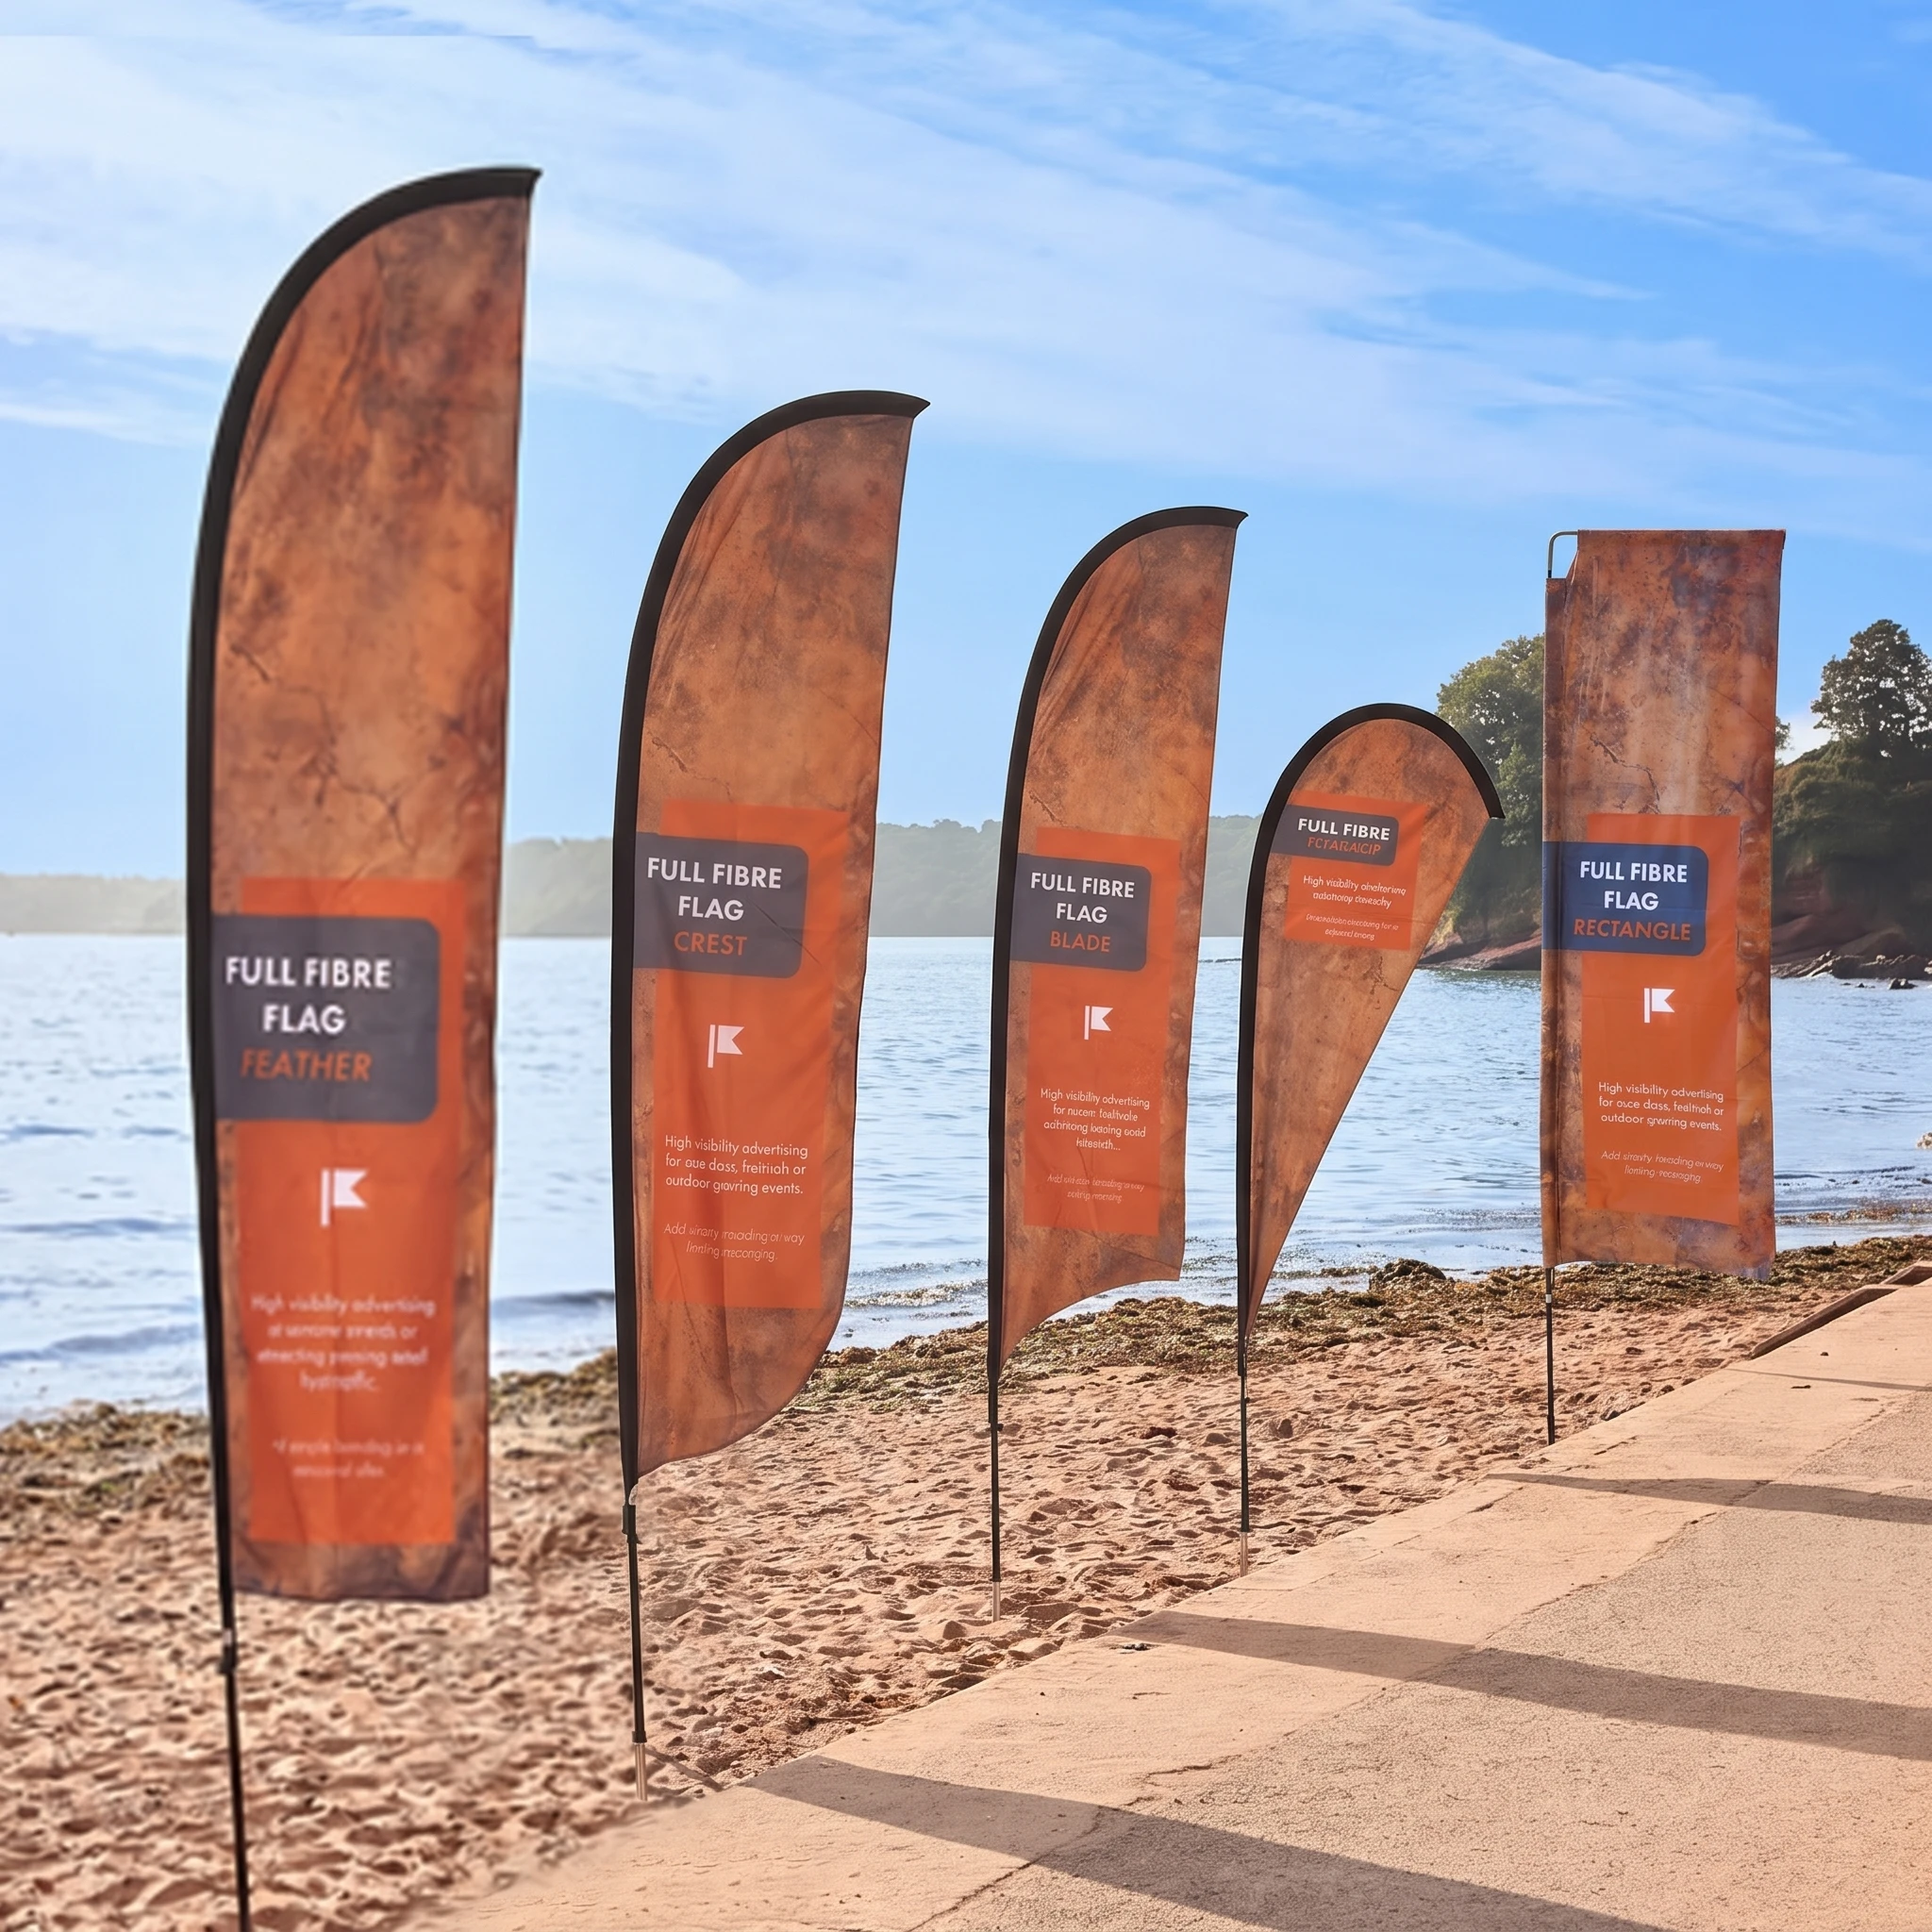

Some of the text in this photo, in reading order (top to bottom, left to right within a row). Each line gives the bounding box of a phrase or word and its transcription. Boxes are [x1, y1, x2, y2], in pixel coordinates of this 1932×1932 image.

[1297, 818, 1391, 841] FULL FIBRE
[647, 858, 782, 889] FULL FIBRE
[1580, 860, 1688, 883] FULL FIBRE
[1030, 872, 1135, 898] FULL FIBRE
[678, 895, 744, 921] FLAG
[1604, 891, 1658, 910] FLAG
[1056, 903, 1108, 924] FLAG
[1574, 918, 1690, 941] RECTANGLE
[674, 931, 747, 956] CREST
[1050, 930, 1111, 953] BLADE
[225, 957, 391, 988] FULL FIBRE
[262, 1005, 346, 1034] FLAG
[240, 1049, 373, 1081] FEATHER
[1598, 1081, 1623, 1095] High
[1625, 1084, 1669, 1098] visibility
[1053, 1103, 1065, 1115] for
[1599, 1096, 1613, 1108] for
[1713, 1108, 1724, 1116] or
[1601, 1113, 1644, 1124] outdoor
[1689, 1122, 1722, 1131] events.
[665, 1135, 808, 1158] High visibility advertising
[665, 1153, 681, 1167] for
[792, 1164, 807, 1175] or
[761, 1182, 804, 1194] events.
[663, 1222, 687, 1235] Add
